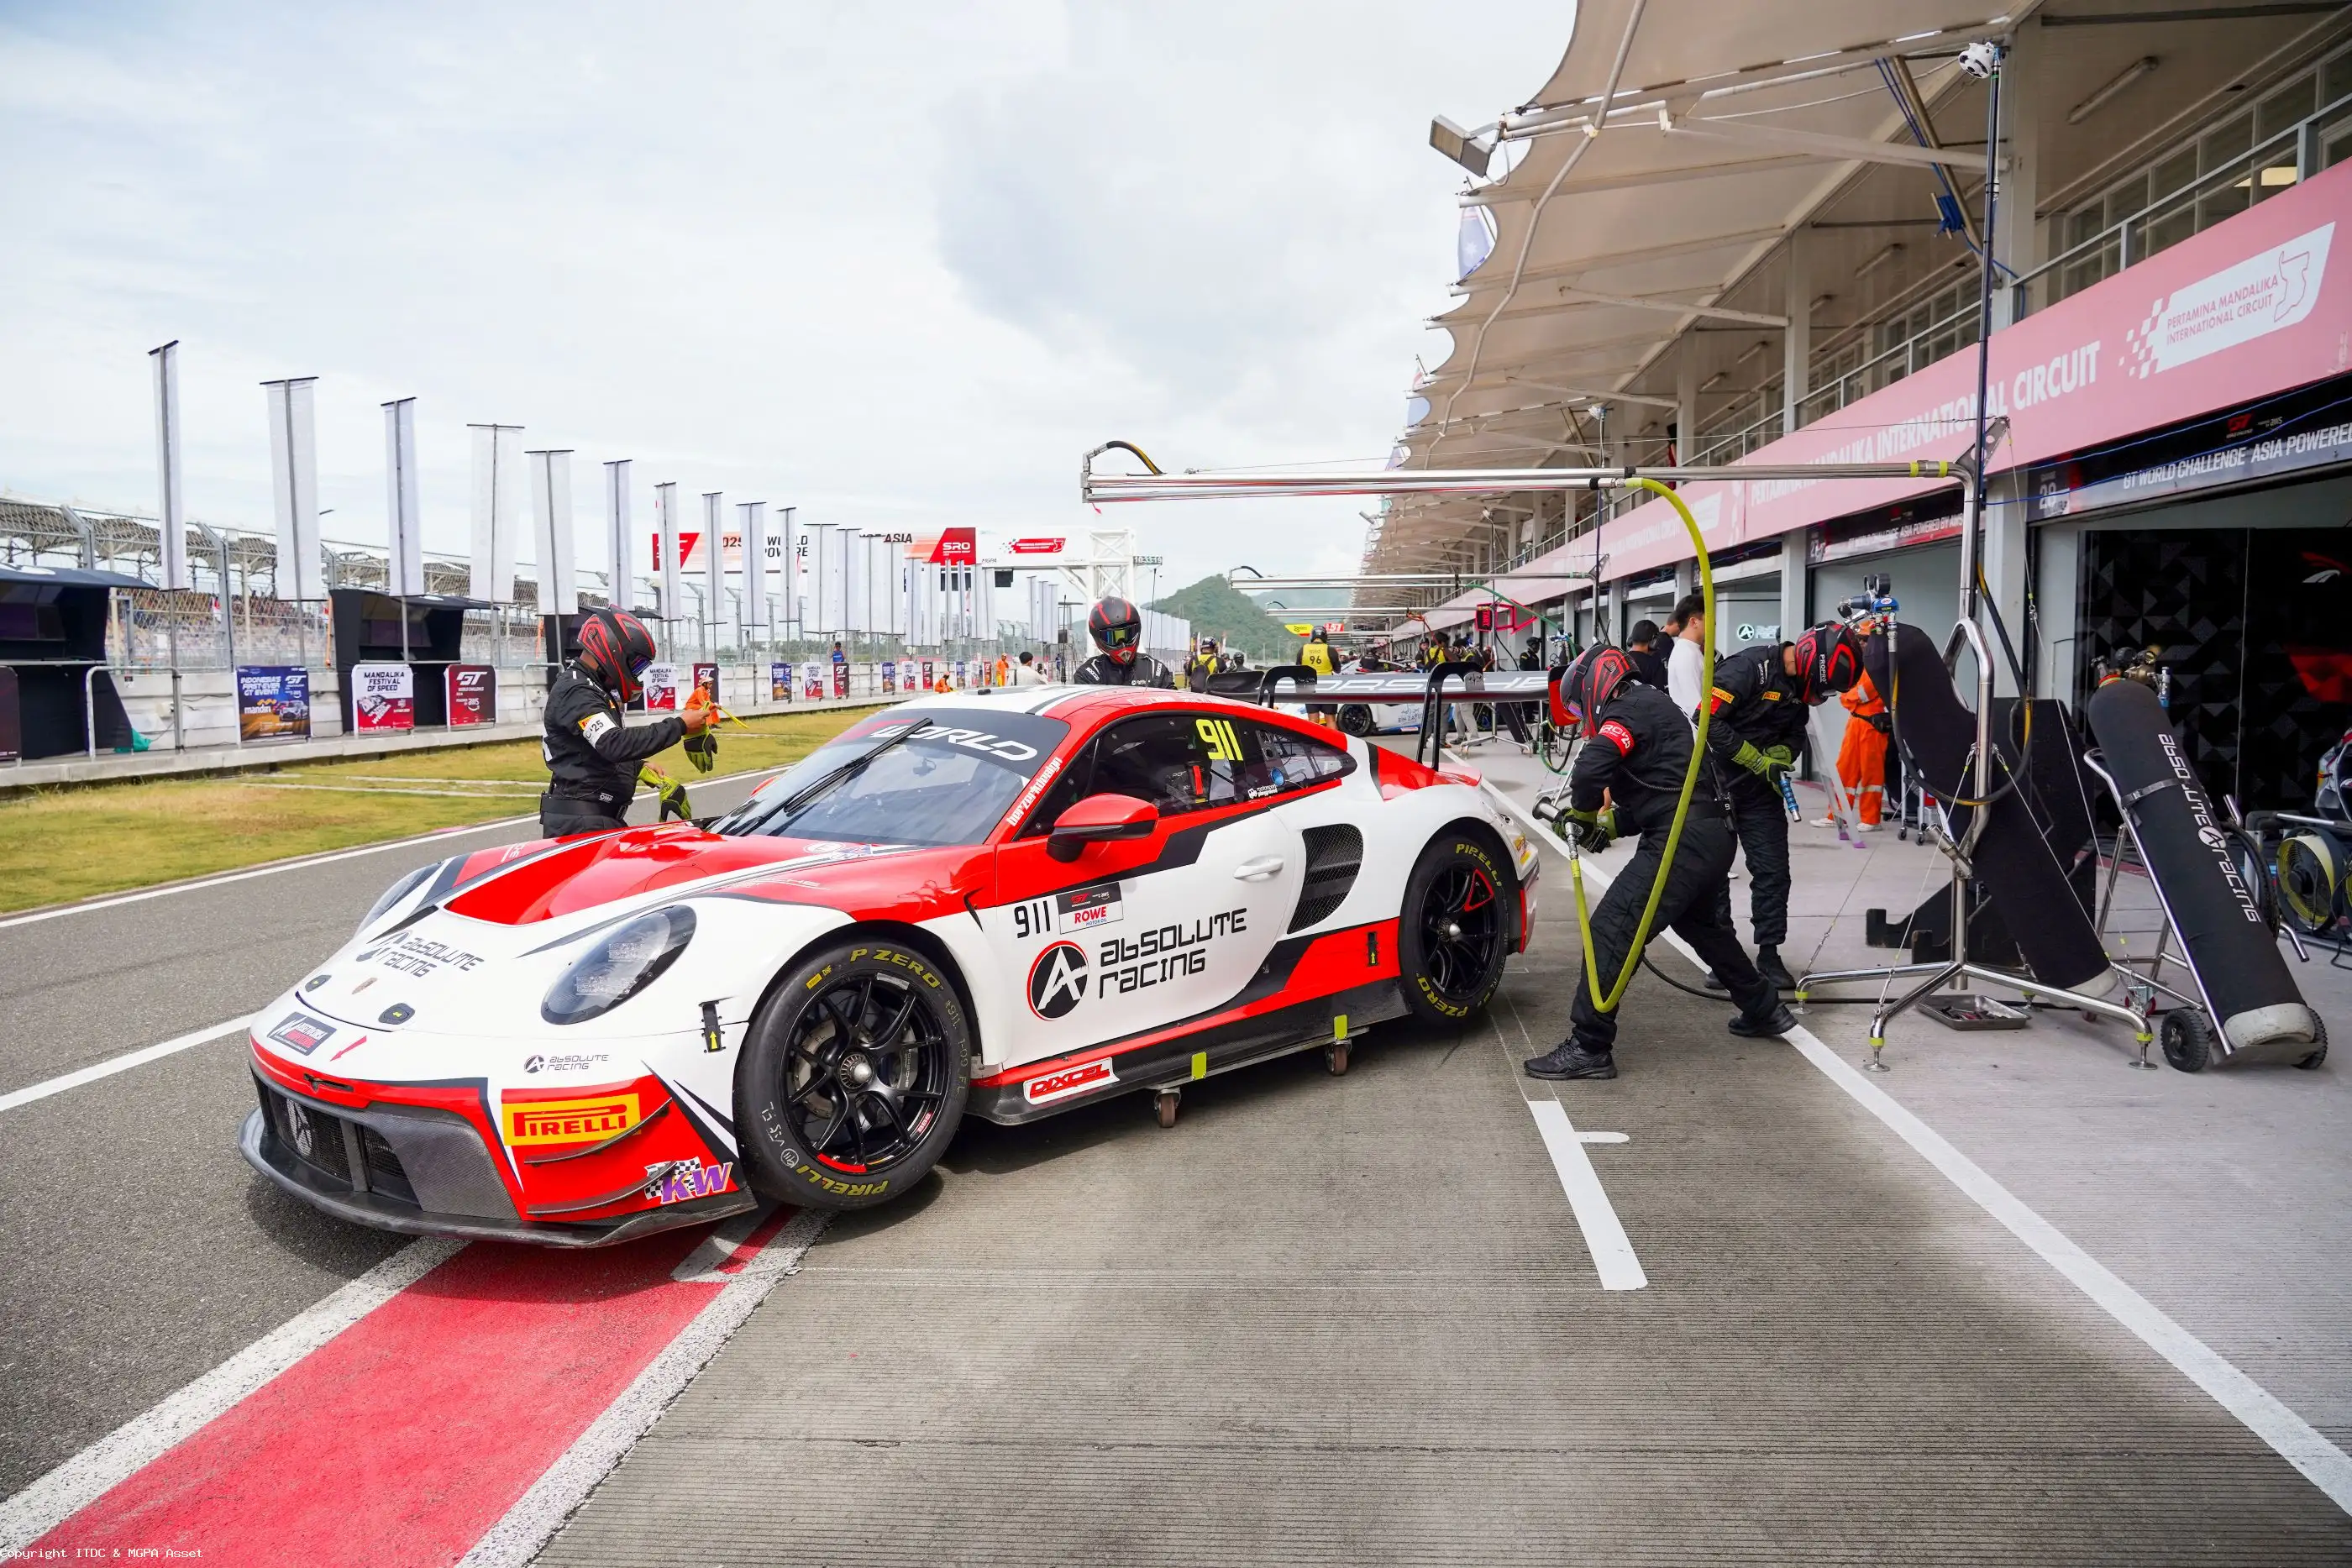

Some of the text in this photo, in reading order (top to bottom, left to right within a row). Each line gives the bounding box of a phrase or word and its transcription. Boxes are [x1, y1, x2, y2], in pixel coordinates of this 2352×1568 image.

[2167, 275, 2278, 330] PERTAMINA MANDALIKA
[2166, 293, 2273, 346] INTERNATIONAL CIRCUIT
[2013, 339, 2101, 411] CIRCUIT
[2124, 471, 2139, 490] GT
[2139, 464, 2176, 488] WORLD
[2177, 447, 2247, 479] CHALLENGE
[2251, 436, 2283, 462] ASIA
[884, 533, 912, 543] ASIA
[1899, 525, 1913, 538] ASIA
[1913, 518, 1940, 535] POWERED
[1940, 516, 1949, 530] BY
[942, 542, 971, 551] SRO
[836, 665, 847, 674] GT
[1310, 655, 1322, 664] 96
[240, 675, 281, 684] INDONESIA'S
[285, 674, 307, 684] GT
[455, 671, 487, 686] GT
[1713, 688, 1733, 703] PIRELLI
[1195, 719, 1244, 761] 911
[1014, 900, 1052, 939] 911
[1074, 906, 1107, 925] ROWE
[849, 948, 942, 989] P ZERO
[1029, 1062, 1110, 1099] DIXCEL
[513, 1104, 627, 1137] PIRELLI
[661, 1162, 733, 1204] KW
[795, 1164, 890, 1197] PIRELLI
